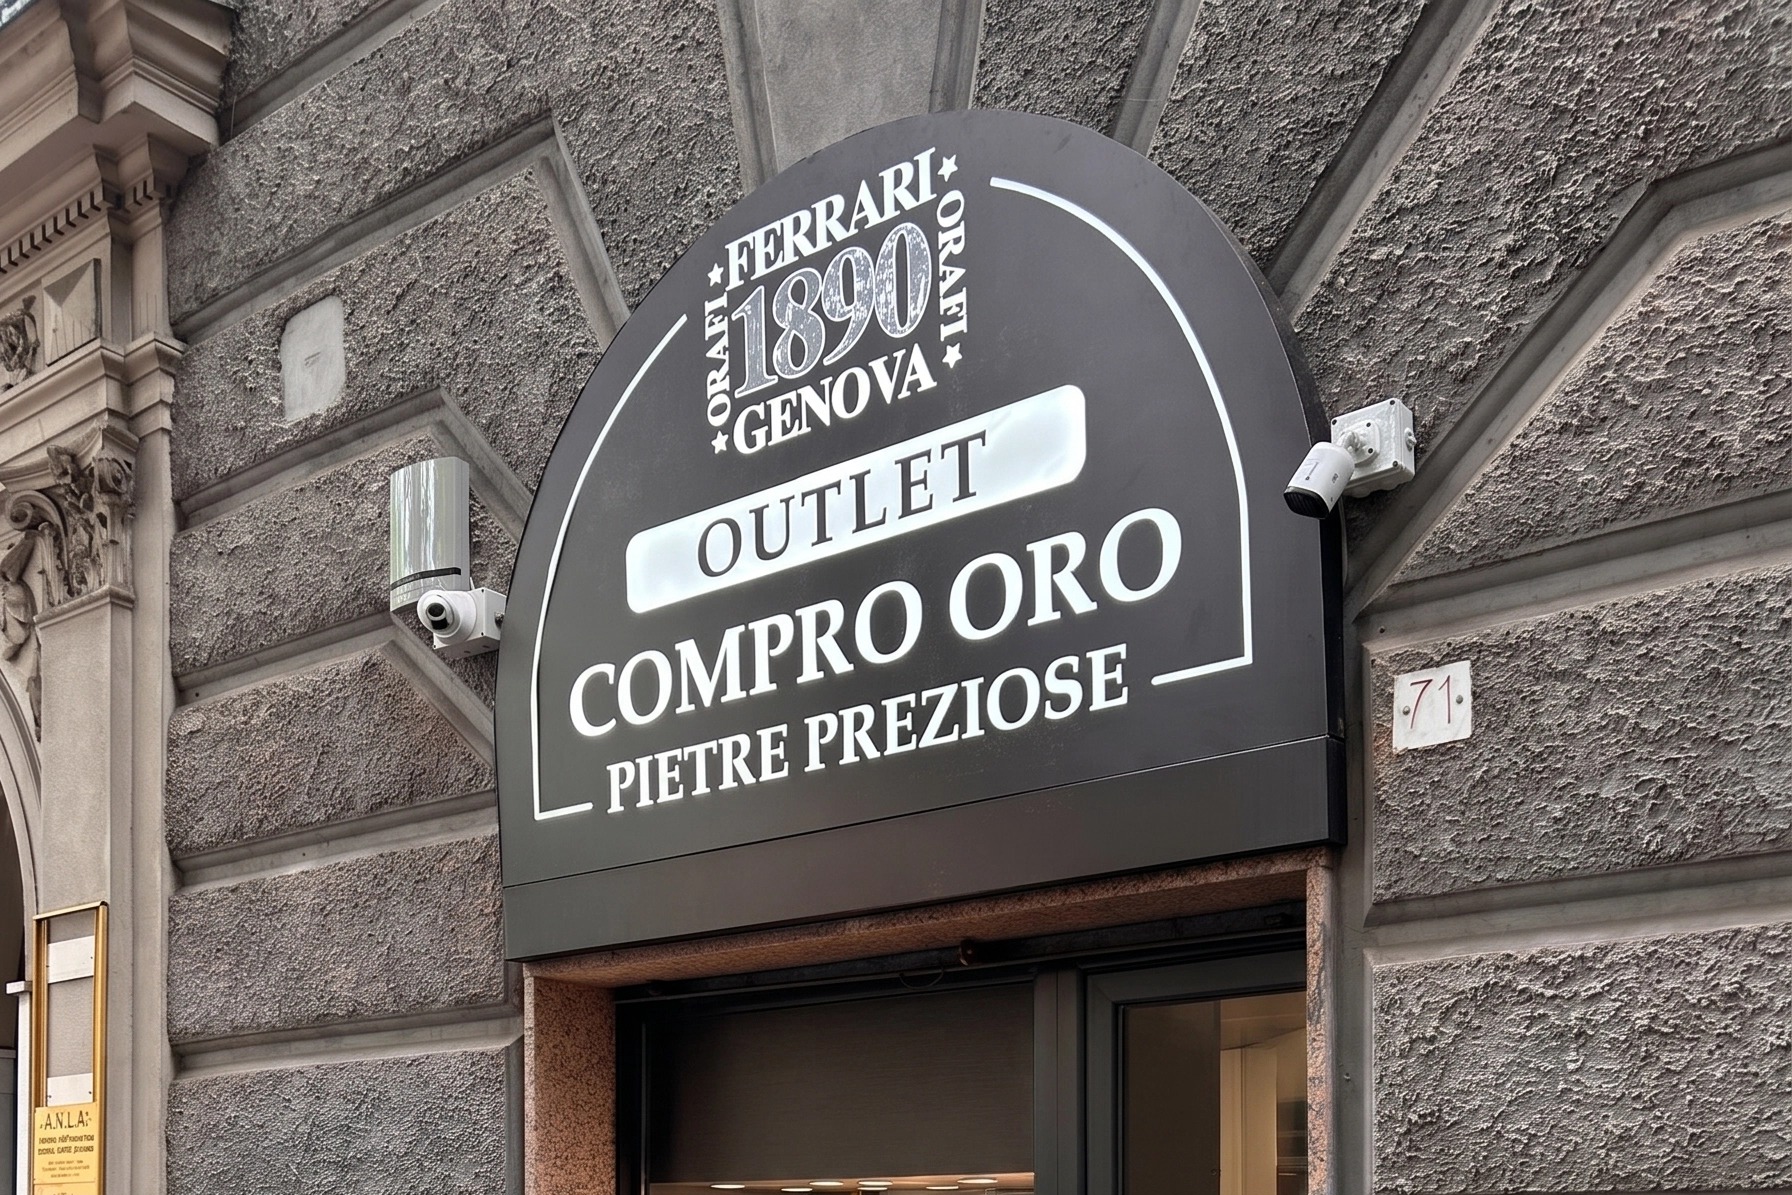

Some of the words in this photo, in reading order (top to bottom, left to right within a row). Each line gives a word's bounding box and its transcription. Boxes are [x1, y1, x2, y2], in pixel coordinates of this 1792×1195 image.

[724, 146, 938, 292] FERRARI
[935, 189, 968, 342] ORAFI
[704, 291, 732, 427] ORAFI
[731, 221, 933, 398] 1890
[733, 342, 938, 455] GENOVA
[698, 430, 986, 578] OUTLET
[569, 580, 923, 738] COMPRO
[949, 507, 1182, 641] ORO
[606, 724, 790, 814] PIETRE
[803, 643, 1129, 773] PREZIOSE
[1410, 675, 1451, 729] 71
